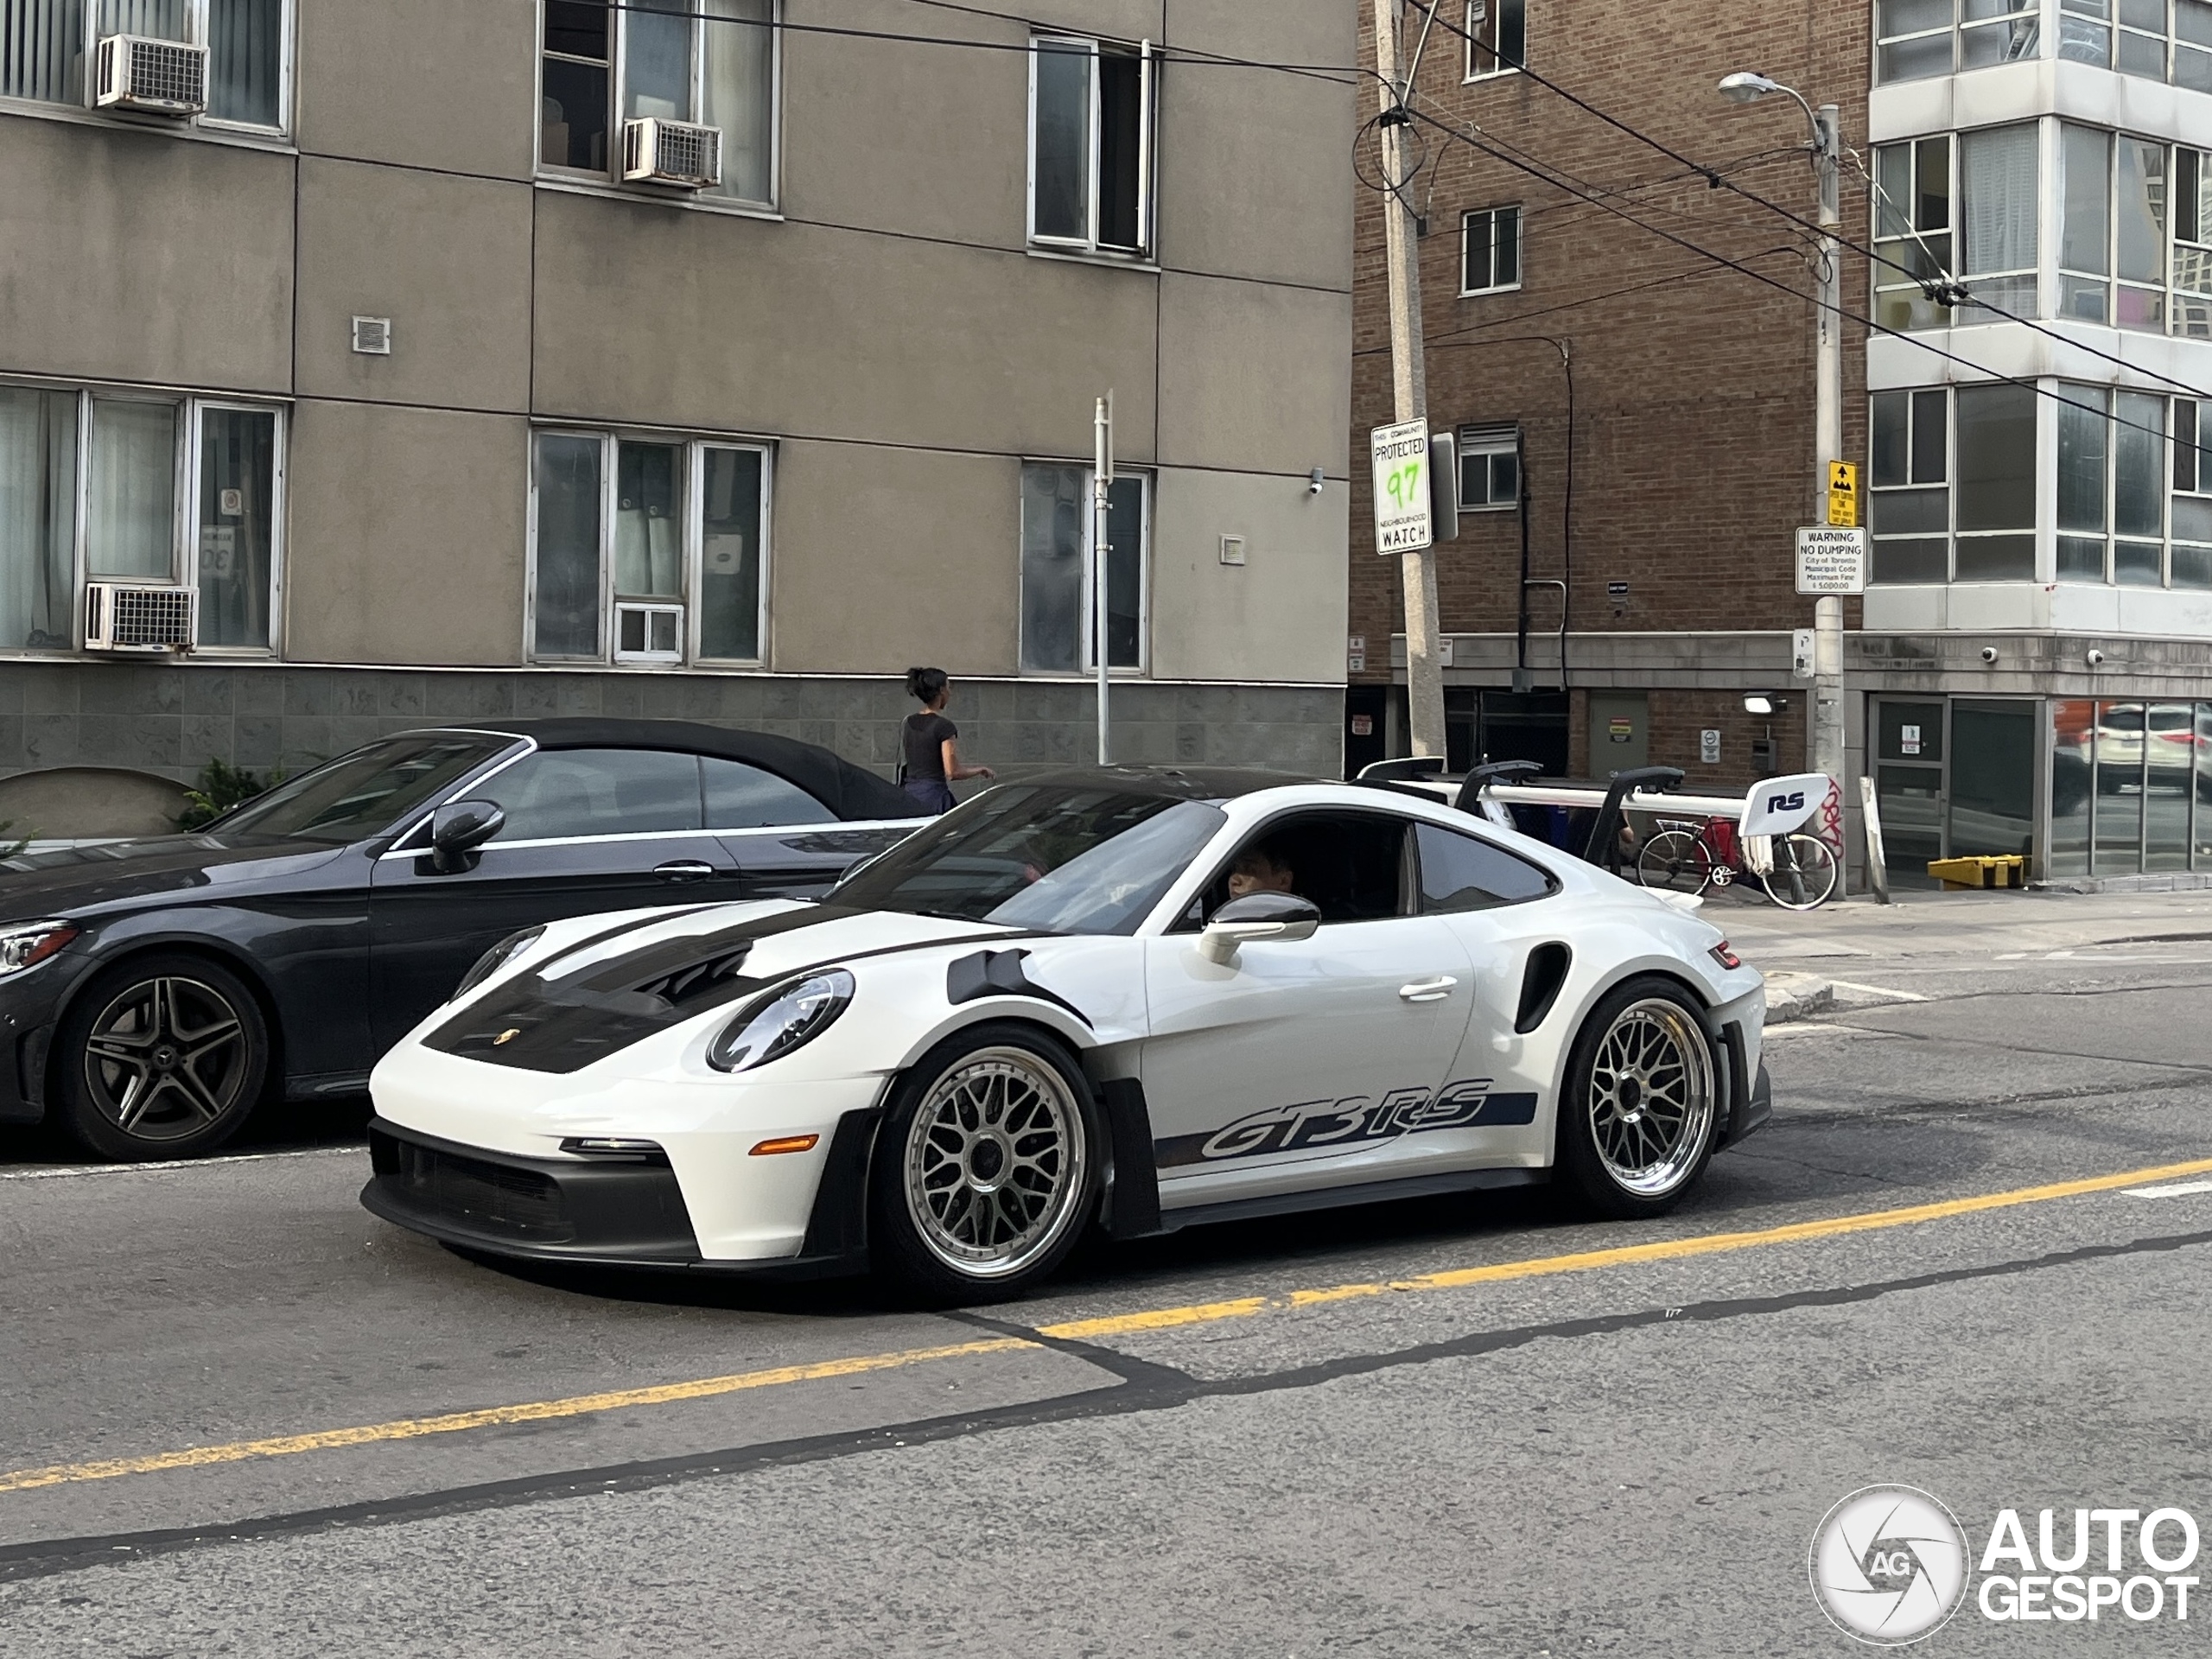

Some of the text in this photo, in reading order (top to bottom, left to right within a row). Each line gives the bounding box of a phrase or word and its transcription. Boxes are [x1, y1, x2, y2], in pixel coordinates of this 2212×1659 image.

[1376, 437, 1425, 461] PROTECTED
[1387, 464, 1419, 509] 97
[1382, 525, 1425, 547] WATCH
[1808, 532, 1854, 542] WARNING
[1801, 545, 1861, 555] NO DUMPING
[1767, 791, 1804, 813] RS
